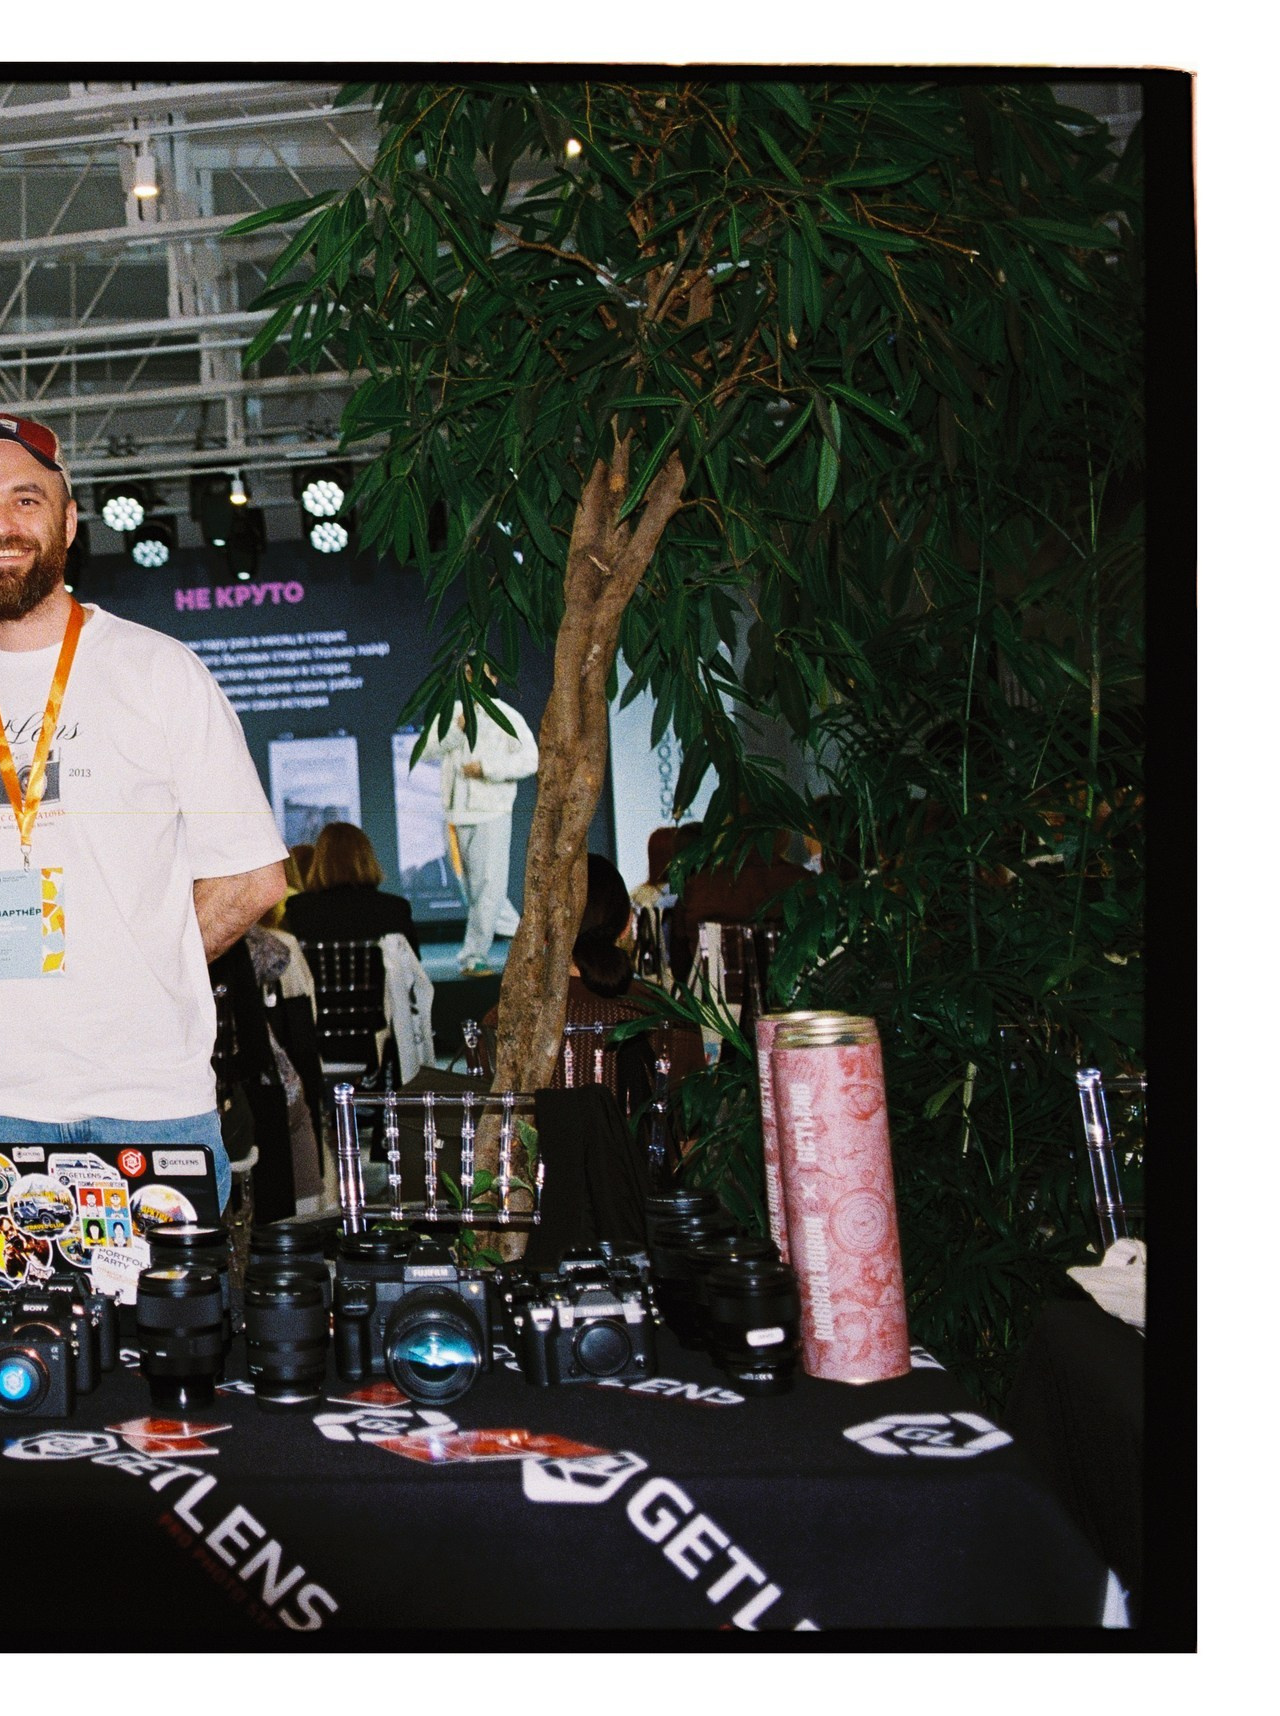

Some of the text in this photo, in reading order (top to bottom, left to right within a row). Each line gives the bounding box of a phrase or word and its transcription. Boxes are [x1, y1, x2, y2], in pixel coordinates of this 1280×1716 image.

[175, 581, 305, 611] НЕ КРУТО
[68, 768, 92, 778] 2013
[97, 1254, 130, 1270] PARTY
[22, 1304, 49, 1312] SONY
[892, 1427, 956, 1447] GL
[91, 1452, 340, 1632] GETLENS
[625, 1476, 821, 1632] GETL
